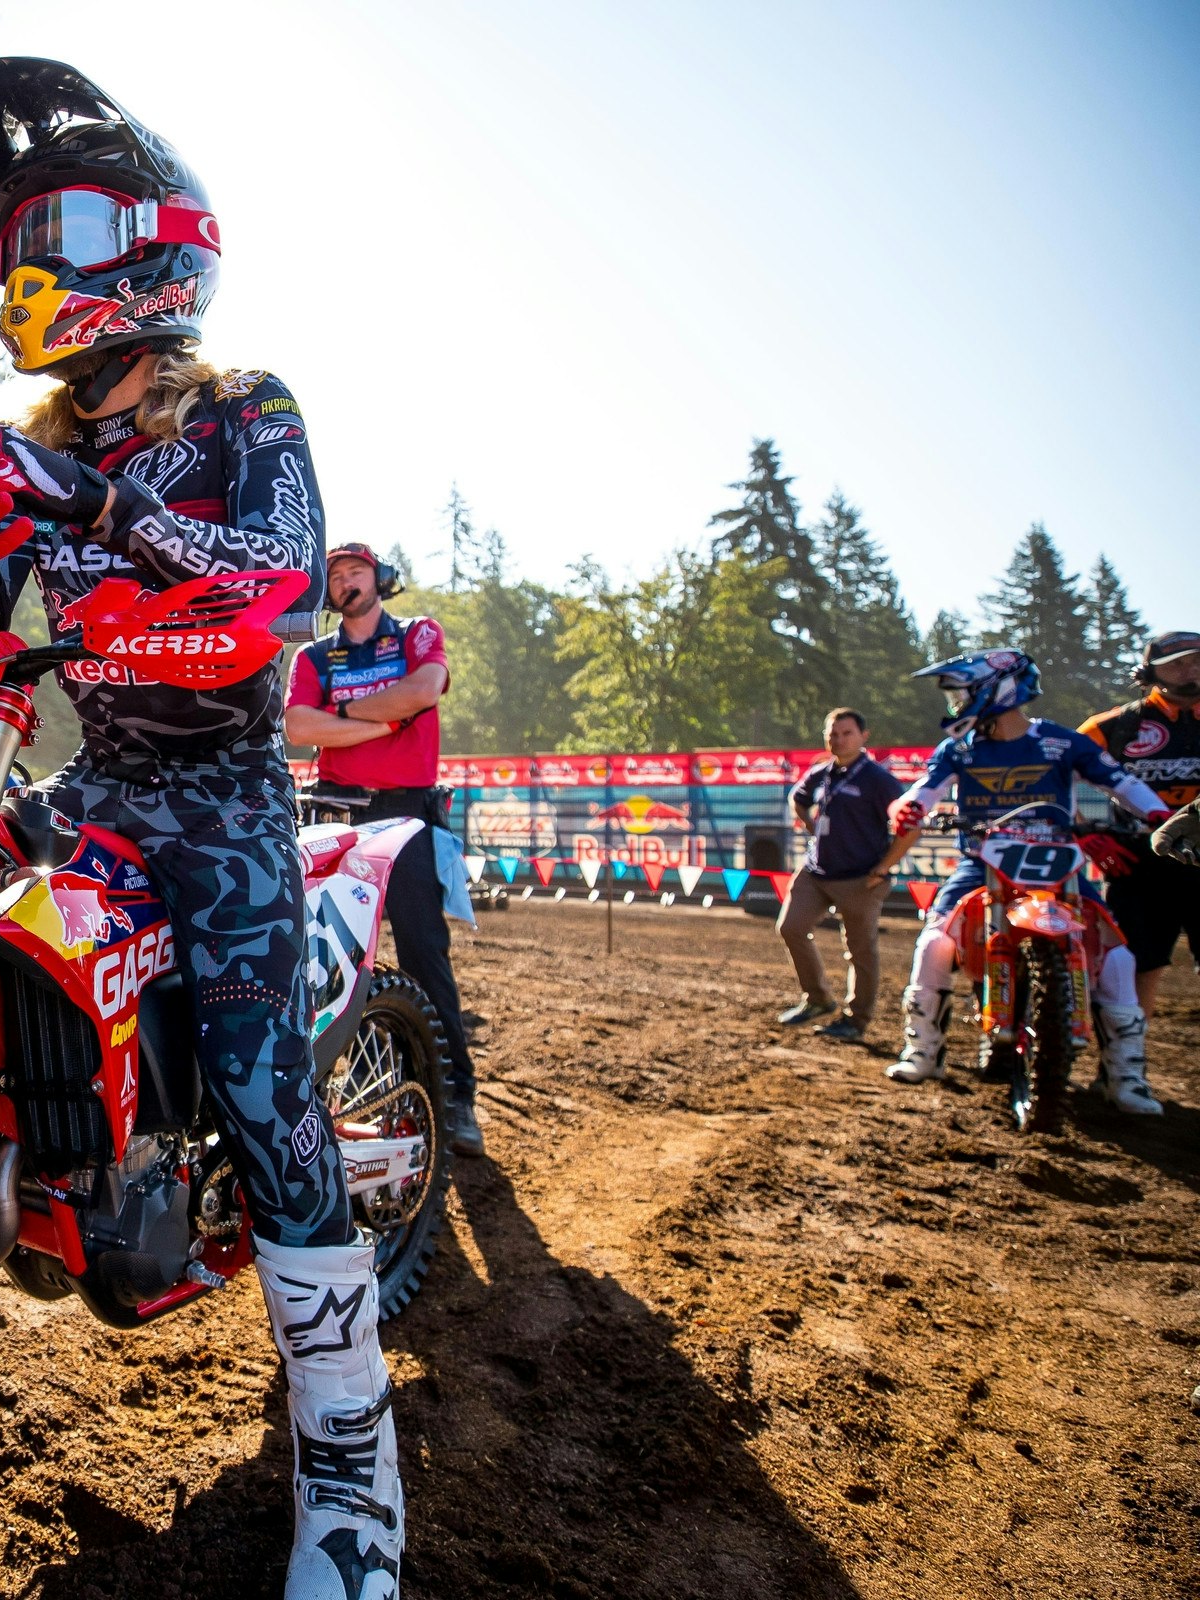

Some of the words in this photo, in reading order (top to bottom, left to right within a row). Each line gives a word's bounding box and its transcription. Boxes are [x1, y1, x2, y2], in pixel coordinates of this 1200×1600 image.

[168, 276, 196, 309] Bull
[96, 415, 122, 434] SONY
[94, 426, 134, 449] PICTURES
[34, 521, 53, 532] OREX
[640, 835, 707, 867] Bull
[124, 864, 139, 876] SONY
[993, 845, 1078, 883] 19
[123, 875, 149, 890] PICTURES
[94, 924, 176, 1020] GASG
